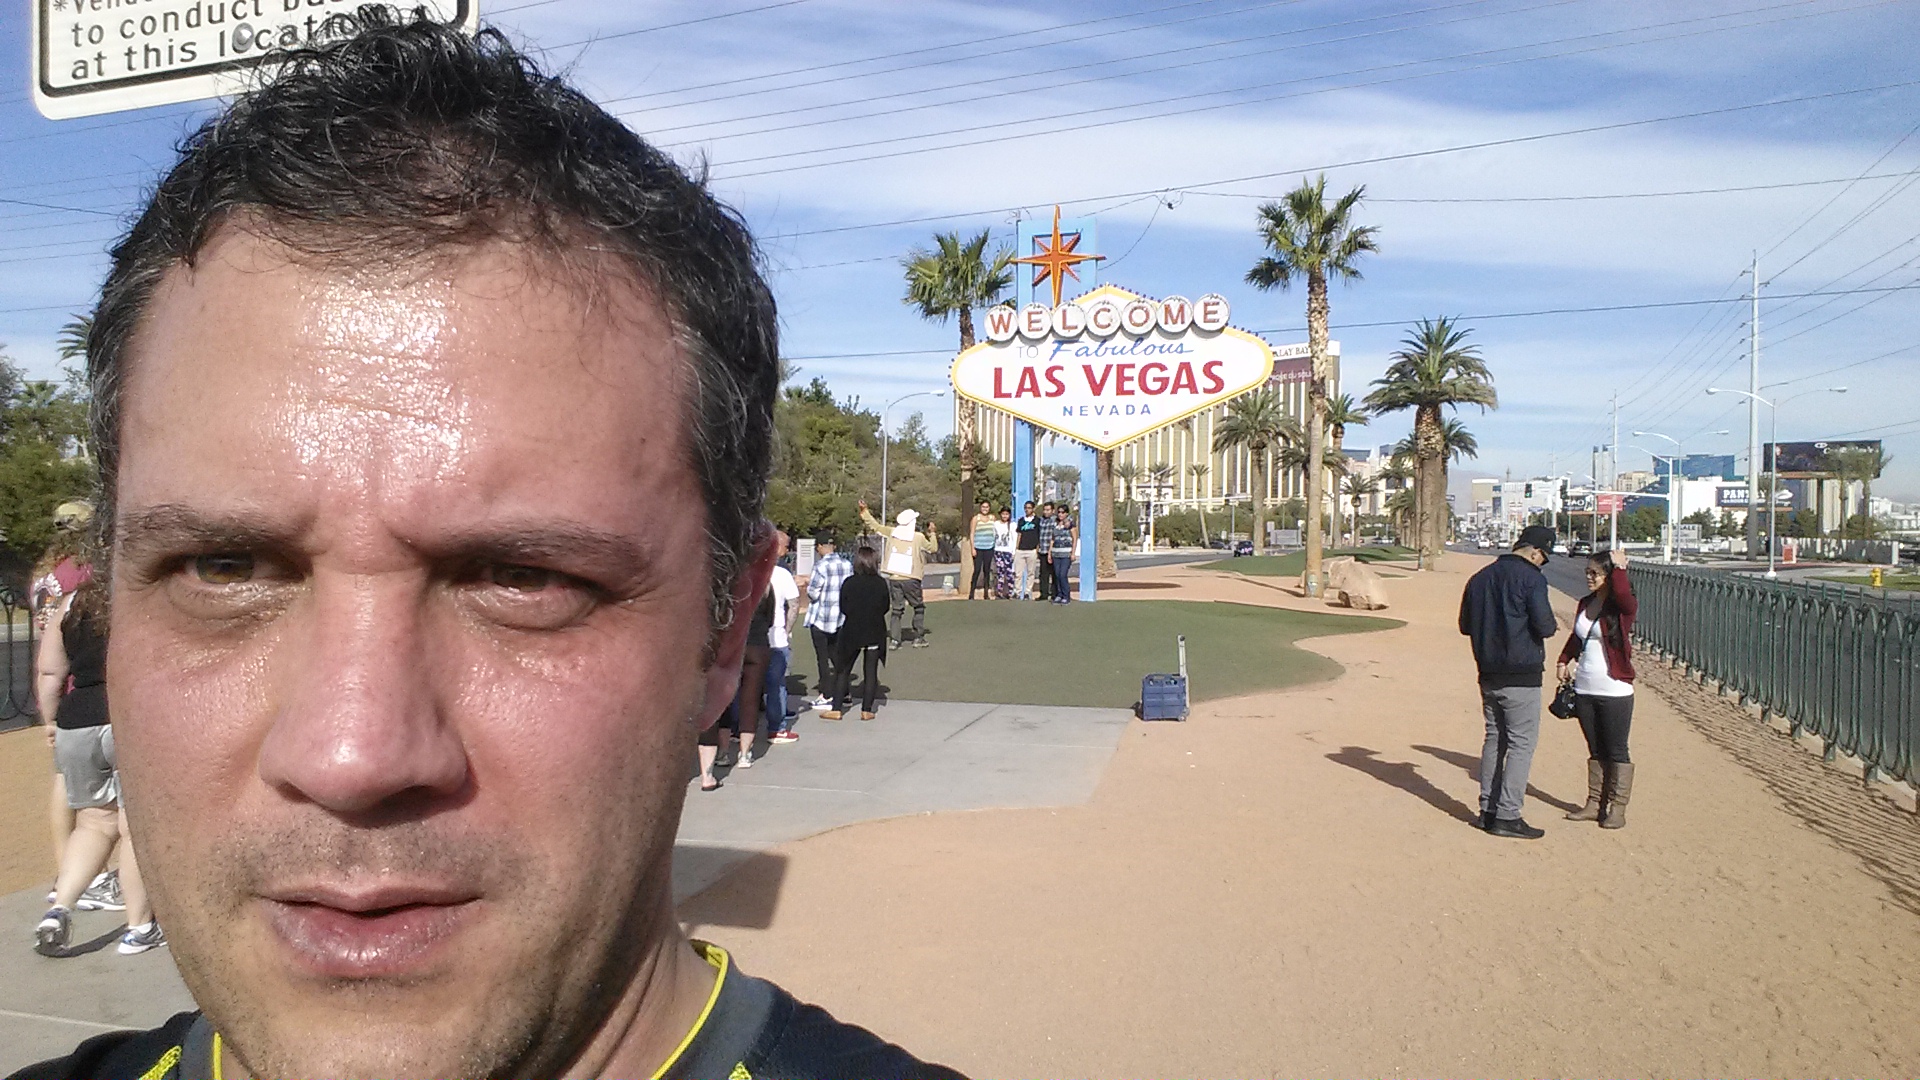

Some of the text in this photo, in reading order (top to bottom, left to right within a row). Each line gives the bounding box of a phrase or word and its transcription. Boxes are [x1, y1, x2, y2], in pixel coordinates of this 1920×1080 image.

[71, 22, 105, 47] to
[119, 0, 263, 40] conduct
[71, 51, 107, 80] at
[124, 38, 198, 71] this
[990, 301, 1220, 335] WELCOME
[1016, 337, 1194, 361] TO Fabulous
[994, 360, 1225, 398] LAS VEGAS
[1062, 403, 1151, 417] NEVADA
[1723, 489, 1767, 499] PANY
